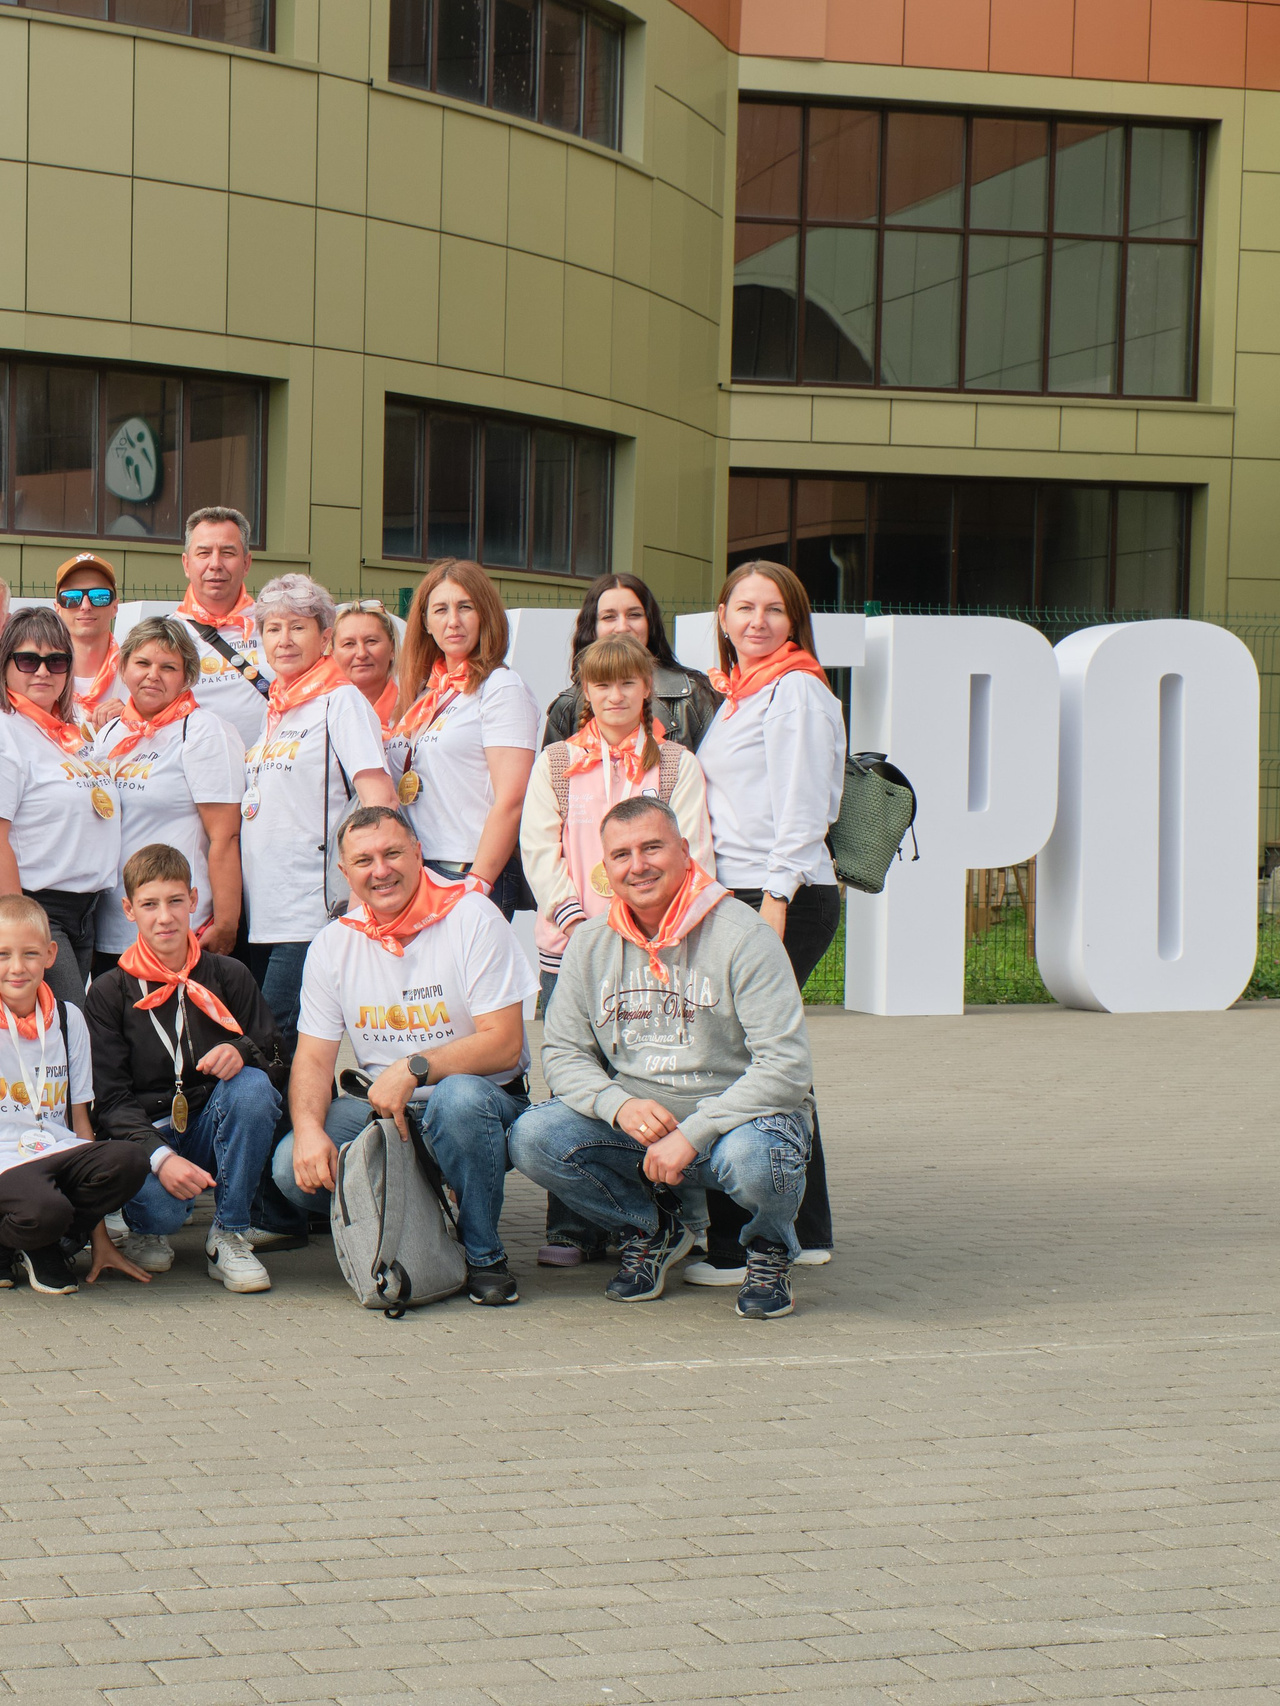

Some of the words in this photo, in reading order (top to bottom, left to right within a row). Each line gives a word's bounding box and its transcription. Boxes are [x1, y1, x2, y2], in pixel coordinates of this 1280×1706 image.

[413, 984, 443, 1001] РУСАГРО
[354, 1001, 452, 1034] ЛЮДИ
[362, 1033, 370, 1041] С
[373, 1028, 455, 1043] ХАРАКТЕРОМ
[45, 1064, 67, 1078] РУСАГР
[645, 1055, 677, 1072] 1979
